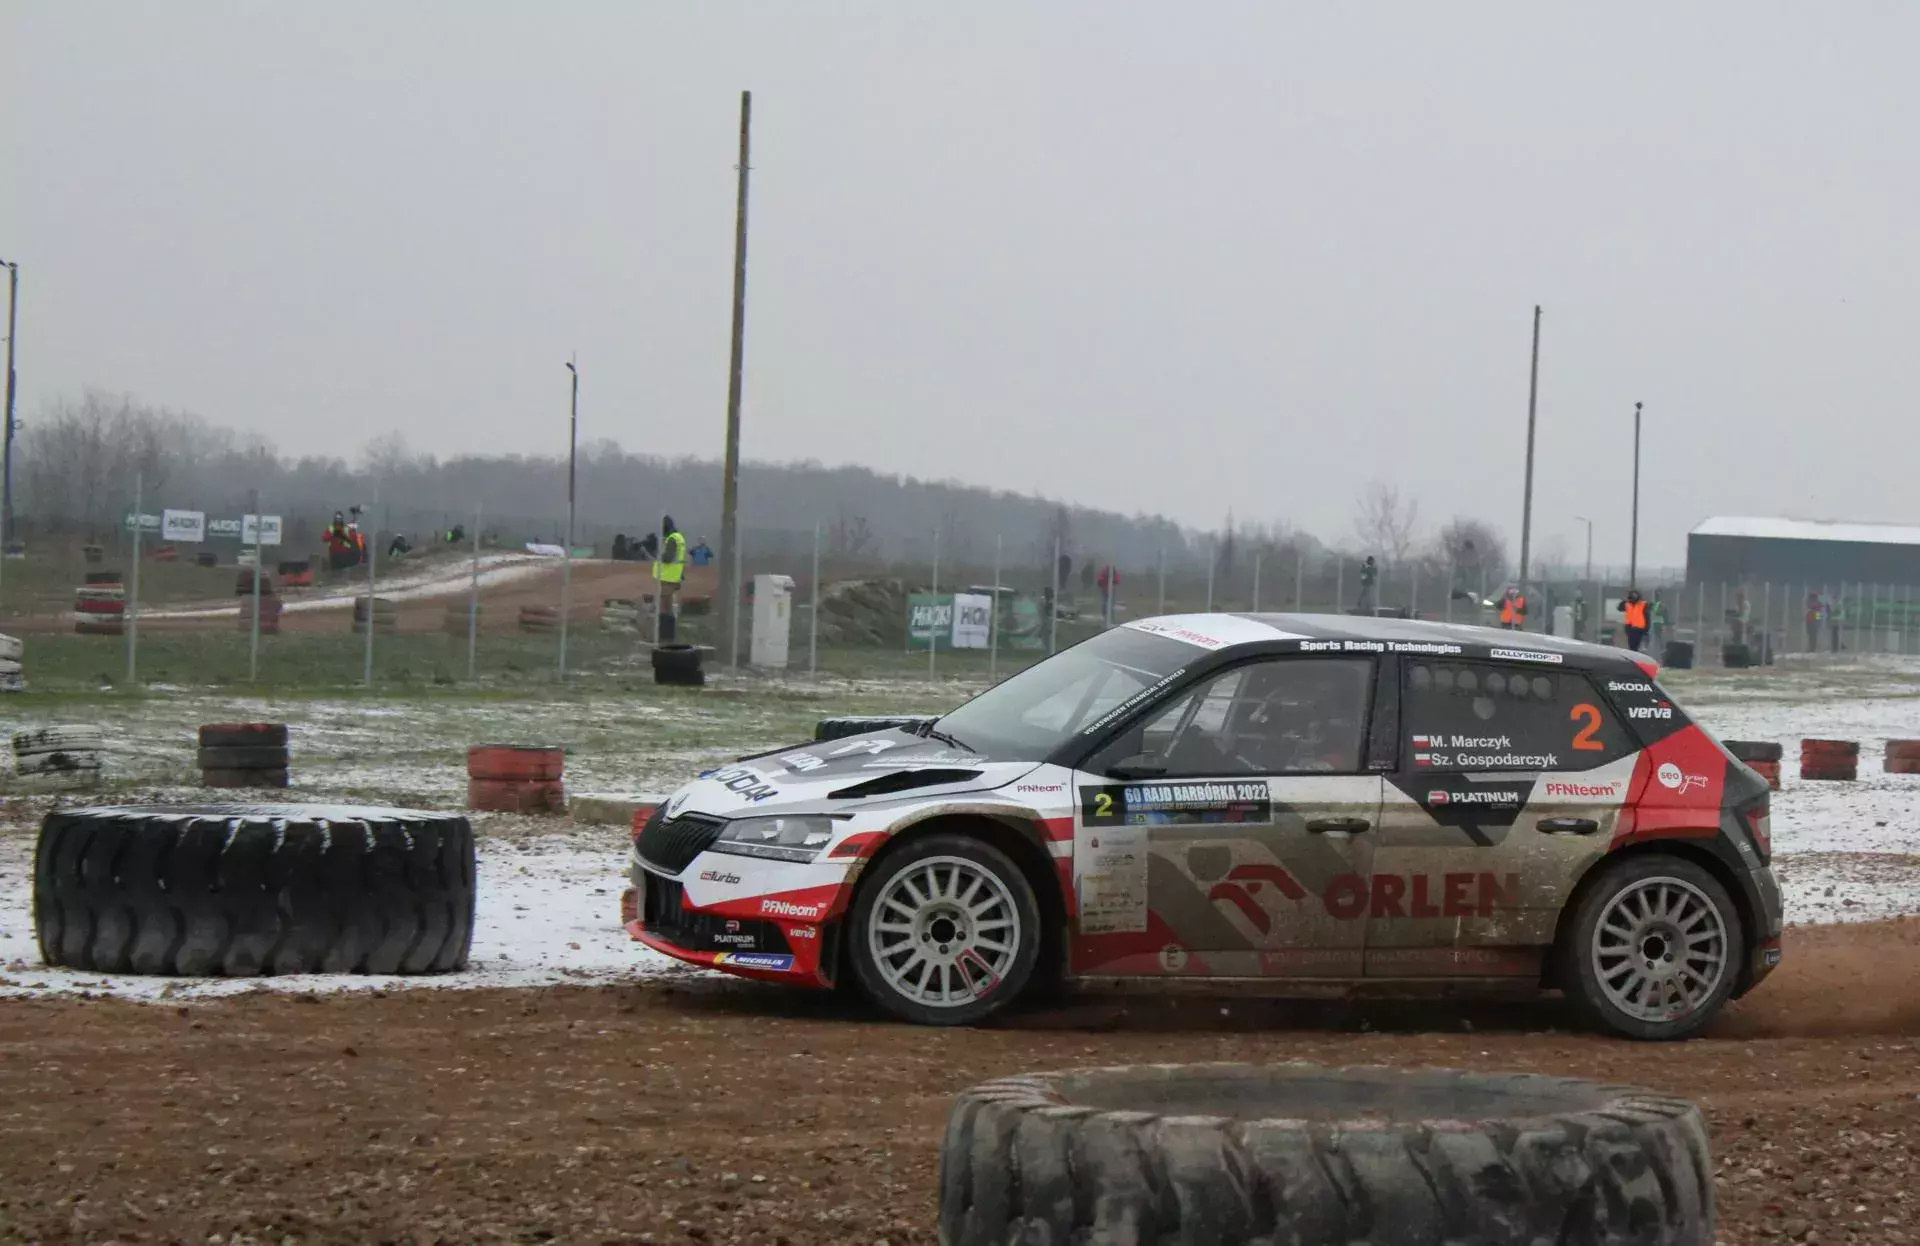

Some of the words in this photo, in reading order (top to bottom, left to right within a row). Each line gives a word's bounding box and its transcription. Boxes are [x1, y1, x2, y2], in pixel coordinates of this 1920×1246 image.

[1300, 640, 1341, 651] Sports
[1344, 640, 1384, 652] Racing
[1387, 641, 1462, 654] Technologies
[1608, 681, 1653, 692] ŠKODA
[1083, 705, 1127, 735] VOLKSWAGEN
[1125, 685, 1159, 708] FINANCIAL
[1157, 668, 1186, 688] SERVICES
[1628, 706, 1672, 719] verva
[1570, 703, 1604, 751] 2
[1430, 735, 1448, 748] M.
[1451, 735, 1511, 750] Marczyk
[1431, 753, 1453, 766] Sz.
[1457, 752, 1558, 768] Gospodarczyk
[1661, 771, 1680, 780] seo
[1017, 784, 1062, 792] PFNteam
[1124, 787, 1140, 803] 60
[1142, 786, 1172, 802] RAJD
[1173, 782, 1237, 802] BARBÓRKA
[1237, 784, 1268, 800] 2022
[1546, 783, 1615, 796] PFNteam
[1451, 792, 1519, 803] PLATINUM
[1094, 793, 1113, 817] 2
[1324, 872, 1520, 920] ORLEN
[761, 899, 818, 917] PFNteam
[714, 934, 755, 943] PLATINUM
[736, 956, 784, 966] MICHELIN
